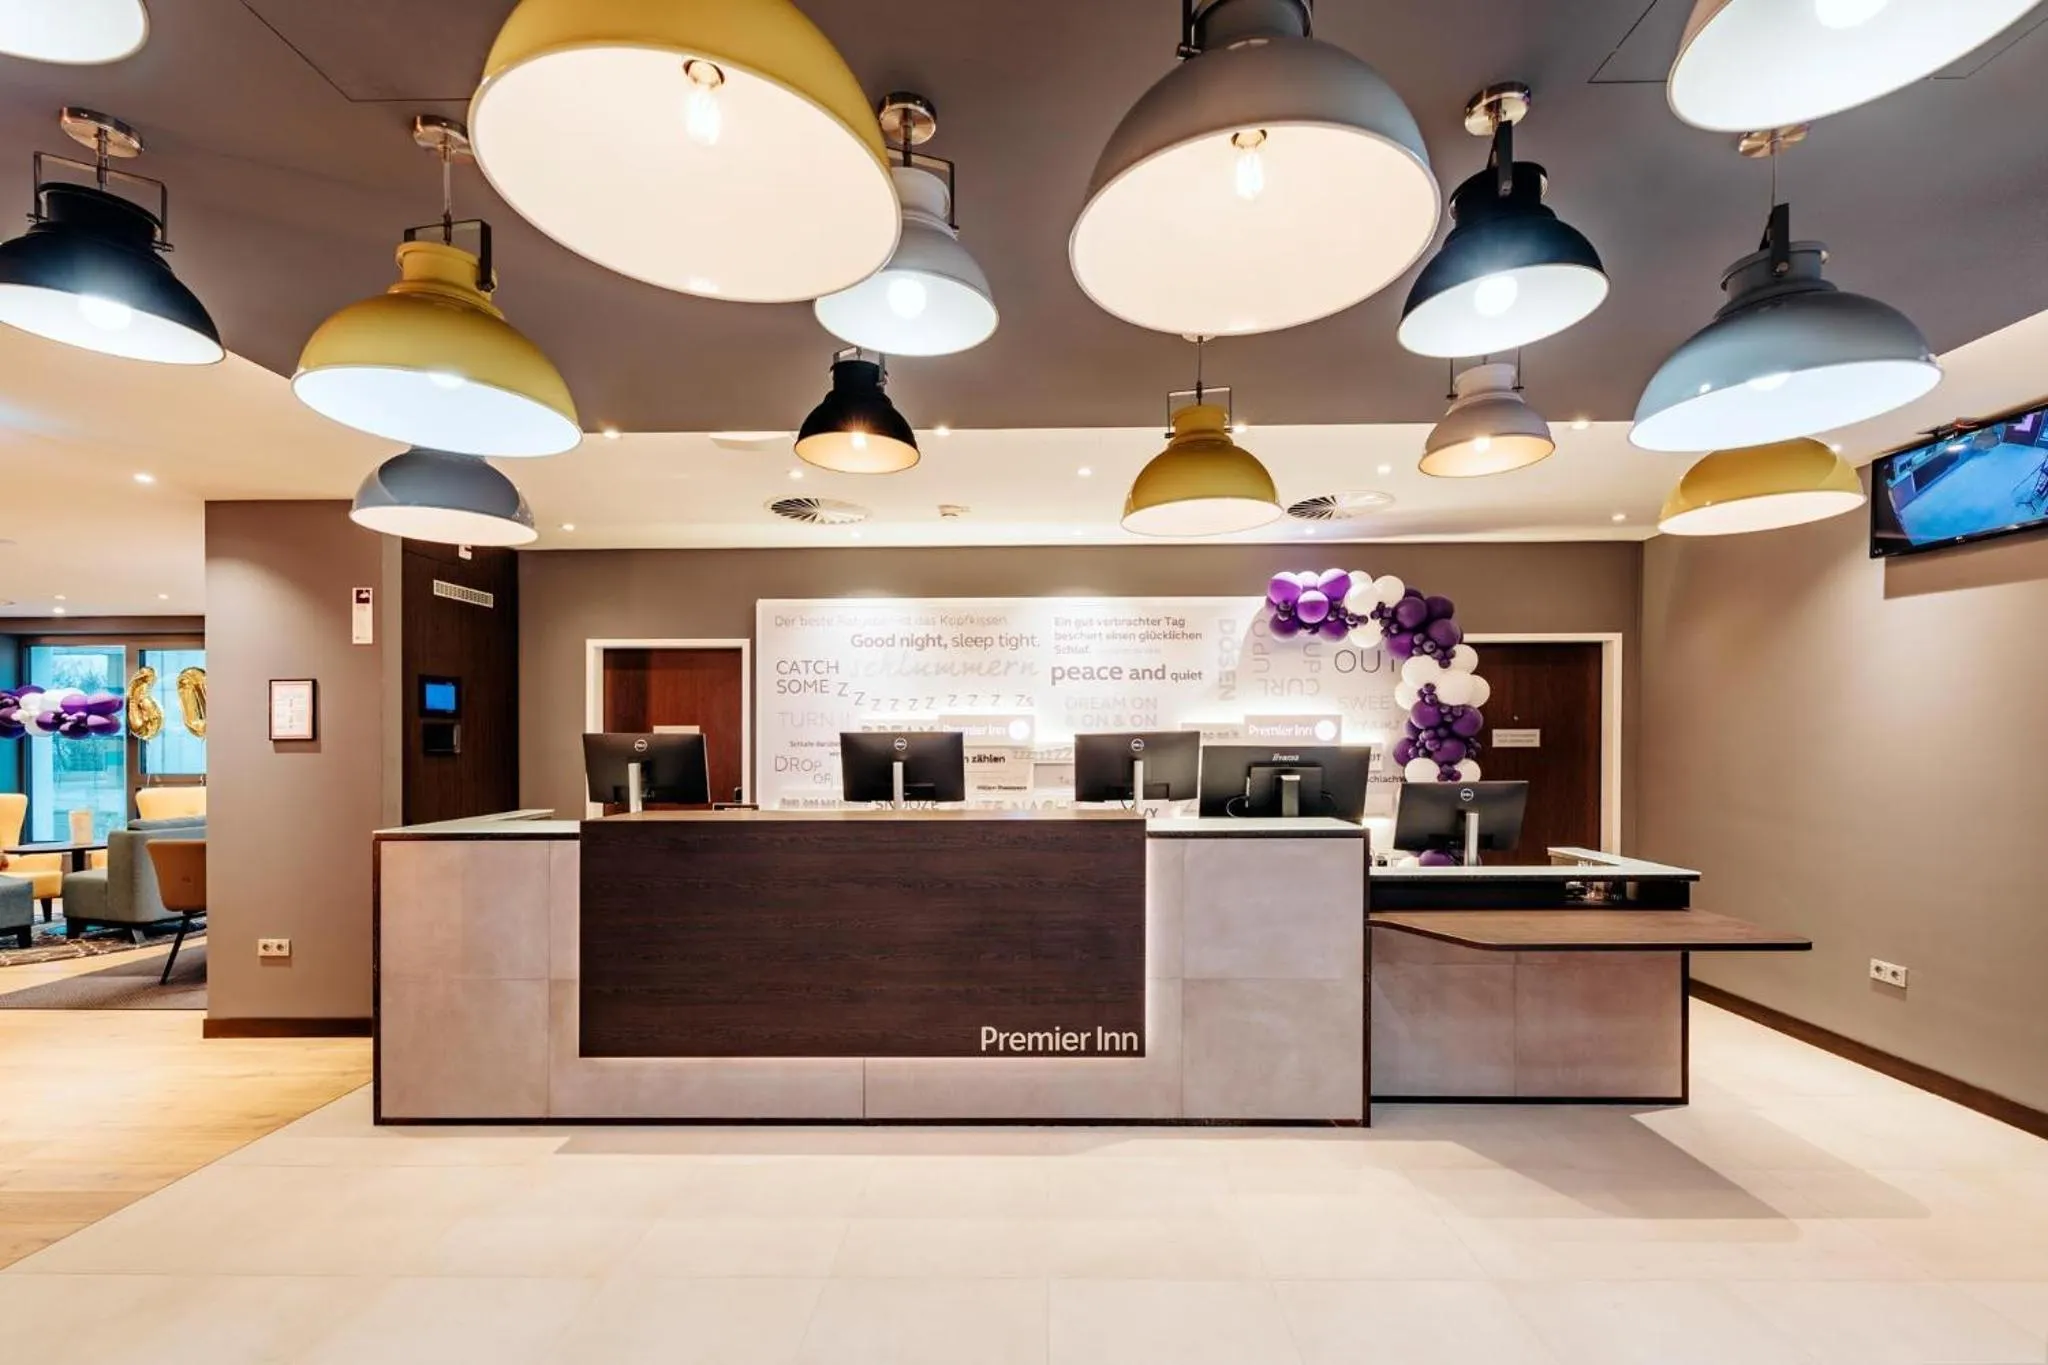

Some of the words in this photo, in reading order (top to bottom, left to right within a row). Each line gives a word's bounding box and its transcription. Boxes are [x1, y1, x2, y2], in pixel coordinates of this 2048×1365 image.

[1054, 617, 1072, 627] Ein
[1074, 617, 1094, 630] gut
[1164, 616, 1186, 628] Tag
[850, 633, 896, 648] Good
[900, 632, 948, 651] night,
[951, 632, 995, 651] sleep
[999, 632, 1041, 651] tight.
[1105, 631, 1136, 641] einen
[776, 659, 840, 676] CATCH
[1050, 664, 1123, 686] peace
[1128, 663, 1167, 682] and
[1170, 669, 1204, 684] quiet
[776, 678, 831, 695] SOME
[1130, 696, 1158, 711] ON
[1337, 694, 1396, 711] SWEE
[1080, 713, 1109, 728] ON
[1129, 713, 1158, 728] ON
[774, 755, 822, 772] DROP
[980, 1025, 1092, 1051] Premier
[1097, 1025, 1139, 1051] Inn
